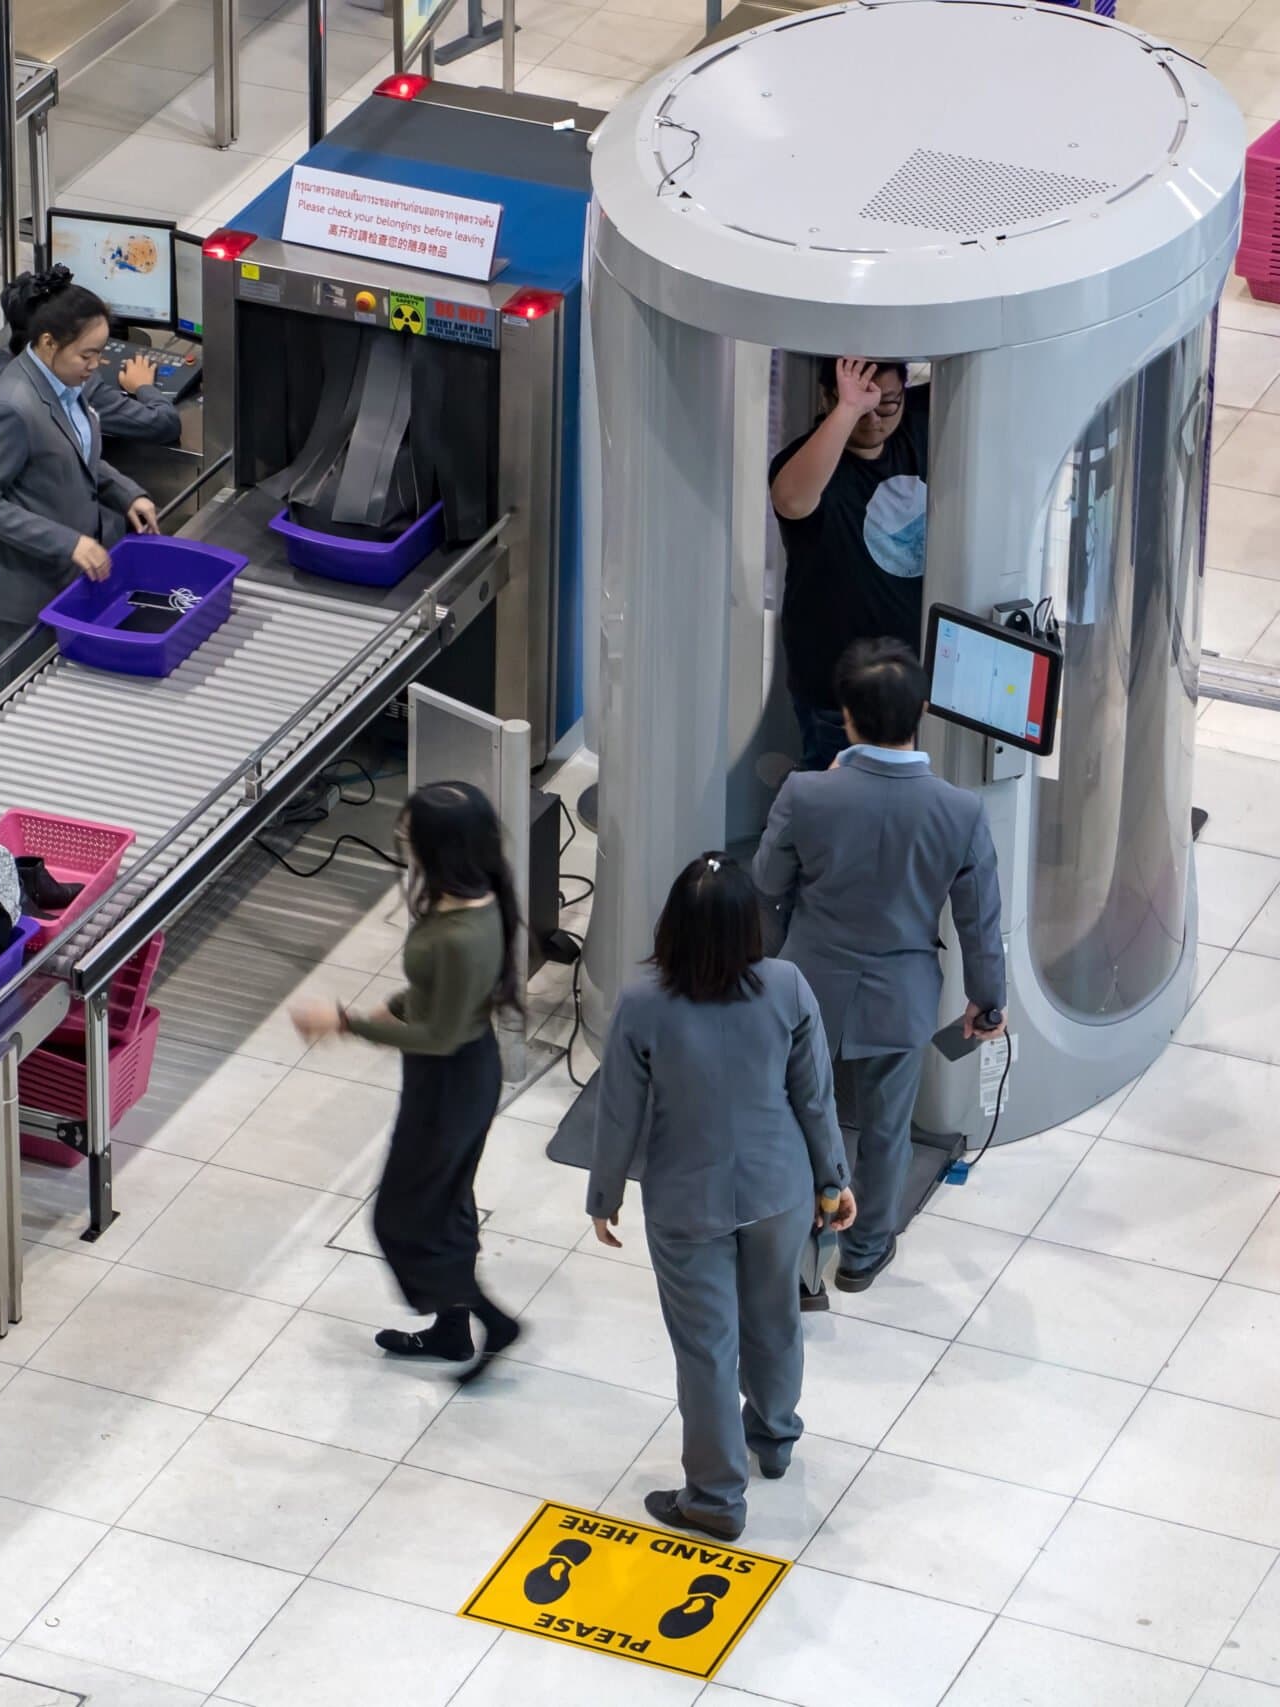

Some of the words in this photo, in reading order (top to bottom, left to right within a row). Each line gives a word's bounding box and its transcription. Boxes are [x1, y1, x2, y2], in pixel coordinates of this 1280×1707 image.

[298, 199, 326, 214] Please
[327, 205, 352, 219] check
[354, 213, 374, 223] your
[376, 215, 422, 234] belongings
[423, 224, 453, 239] before
[454, 230, 486, 248] leaving
[426, 317, 454, 330] INSERT
[454, 322, 468, 332] ANY
[469, 325, 493, 338] PARTS
[434, 300, 455, 318] DO
[458, 305, 486, 324] NOT
[558, 1514, 639, 1545] HERE
[649, 1538, 756, 1575] STAND
[533, 1612, 652, 1653] PLEASE
